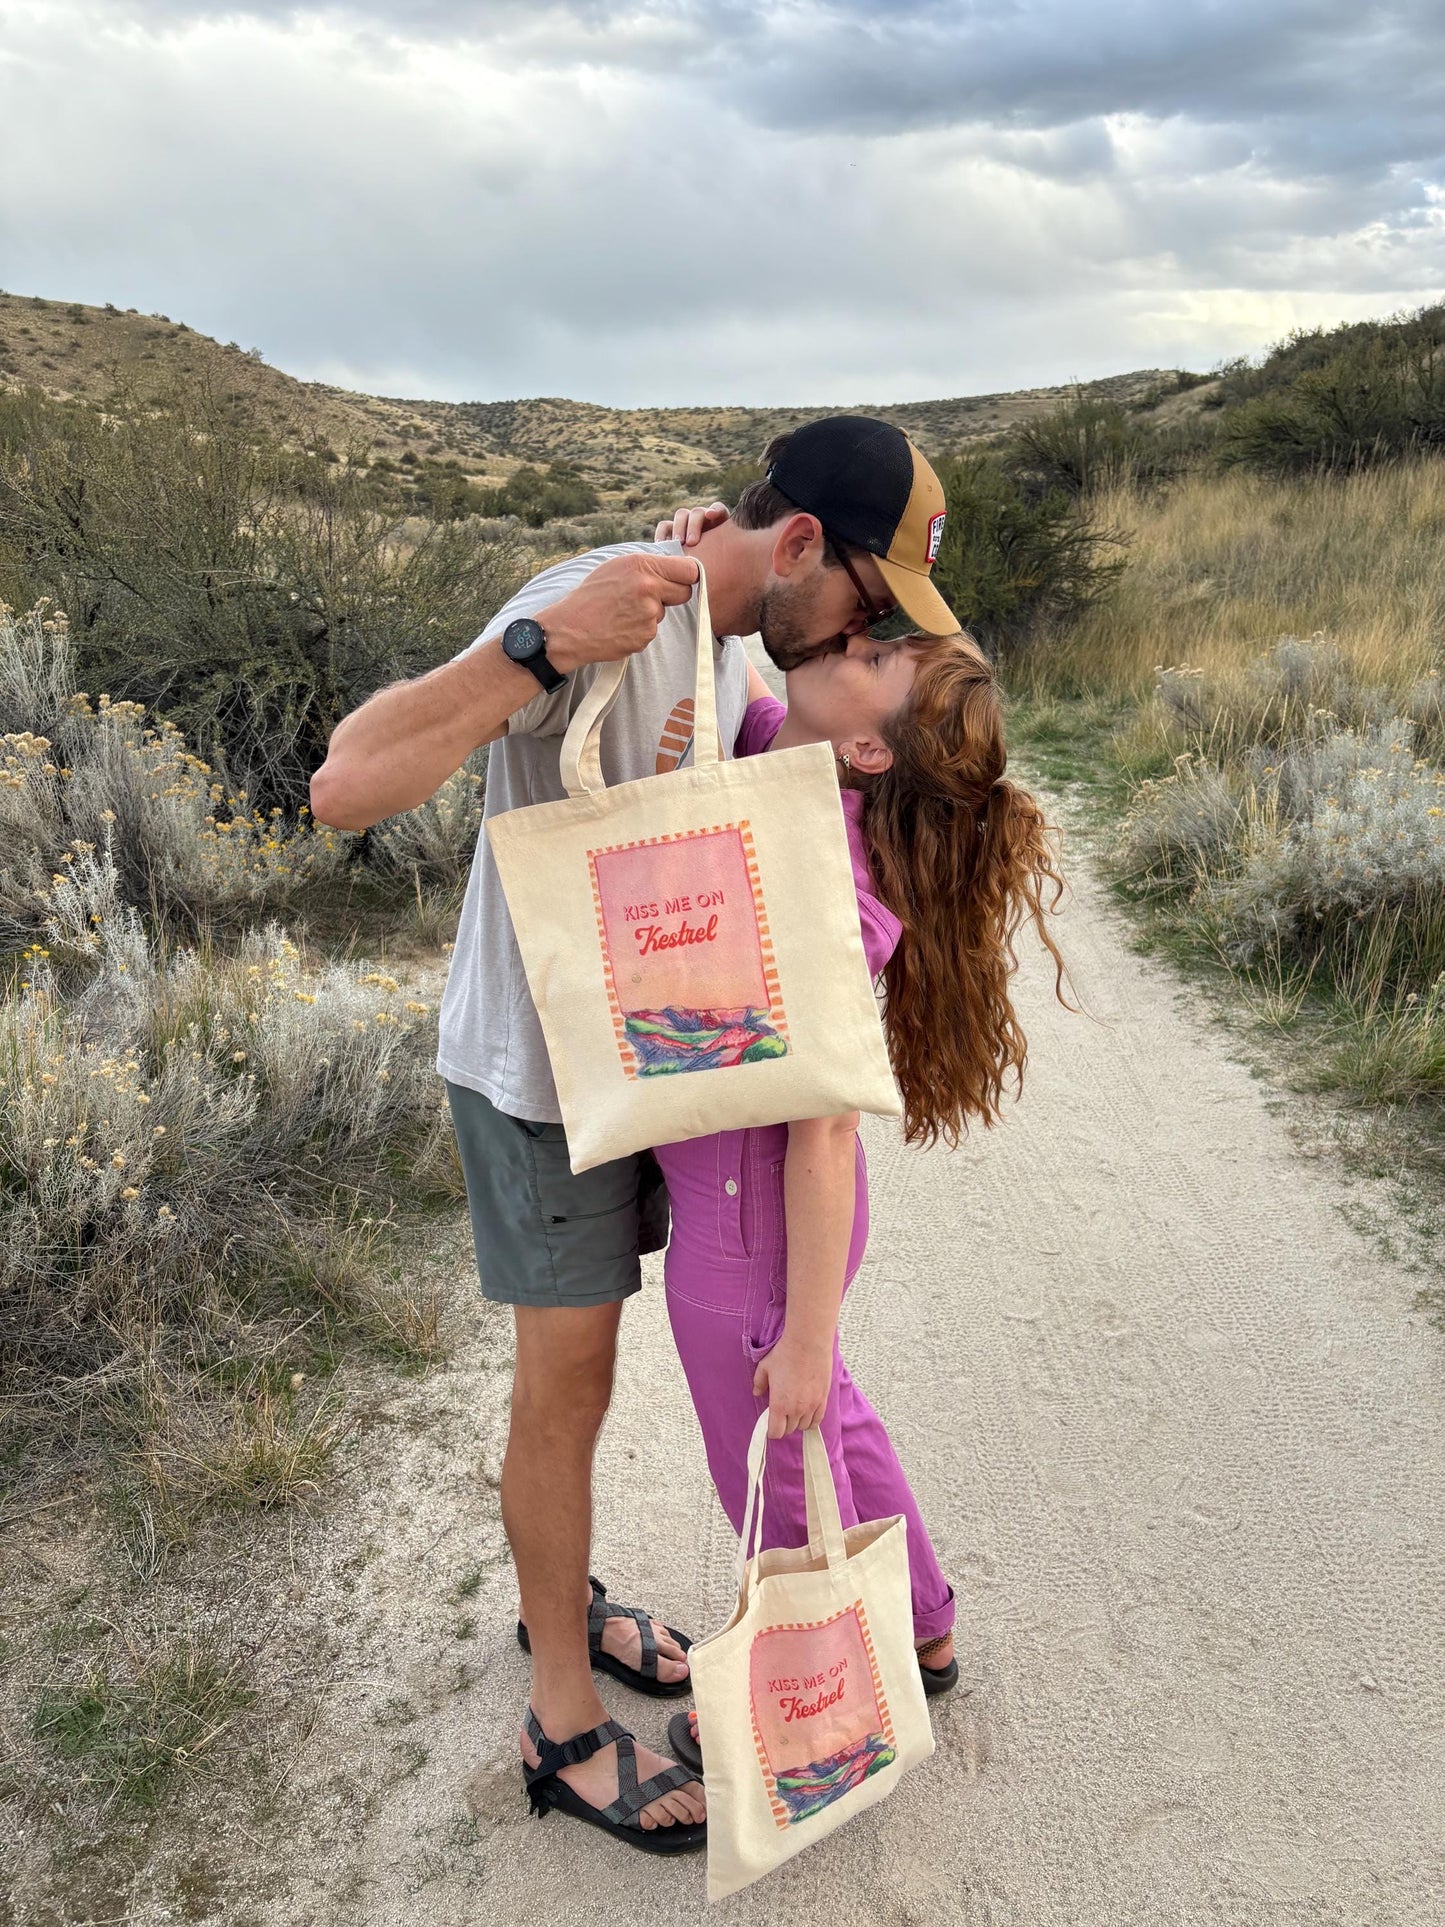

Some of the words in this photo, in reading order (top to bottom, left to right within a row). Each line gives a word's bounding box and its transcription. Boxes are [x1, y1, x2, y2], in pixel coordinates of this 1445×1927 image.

[623, 903, 659, 921] KISS
[664, 896, 692, 915] ME
[697, 890, 725, 908] ON
[634, 913, 718, 956] Kestrel
[768, 1679, 800, 1693] KISS
[803, 1673, 826, 1690] ME
[829, 1658, 848, 1678] ON
[779, 1677, 845, 1723] Kestrel
